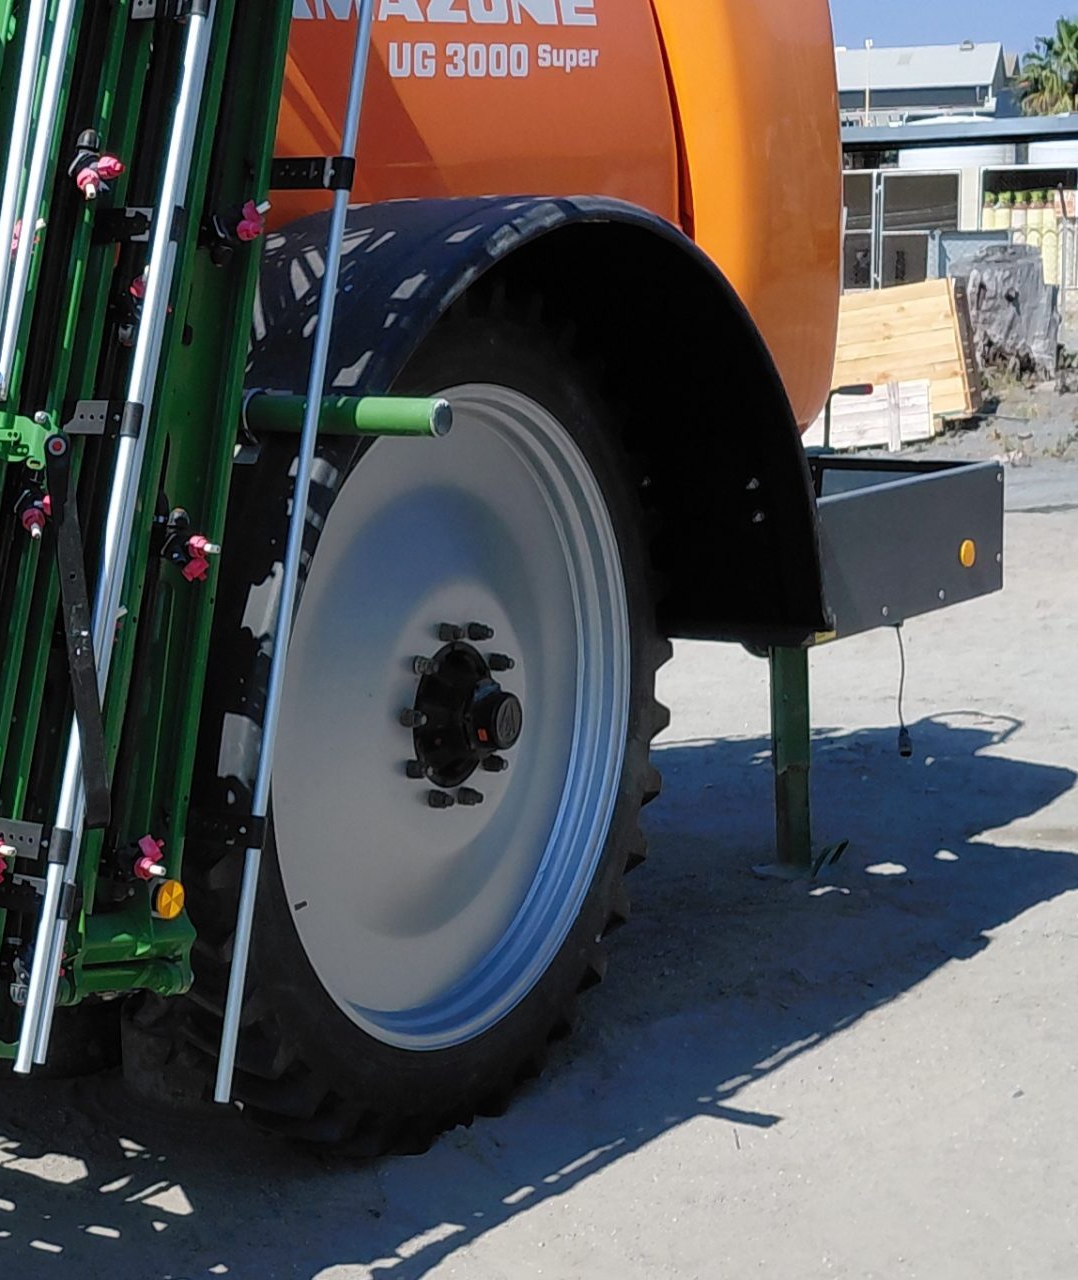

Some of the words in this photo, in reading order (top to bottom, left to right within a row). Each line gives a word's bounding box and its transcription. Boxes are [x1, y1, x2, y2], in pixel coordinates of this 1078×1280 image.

[388, 42, 436, 78] UG
[445, 42, 529, 78] 3000
[537, 44, 599, 73] Super
